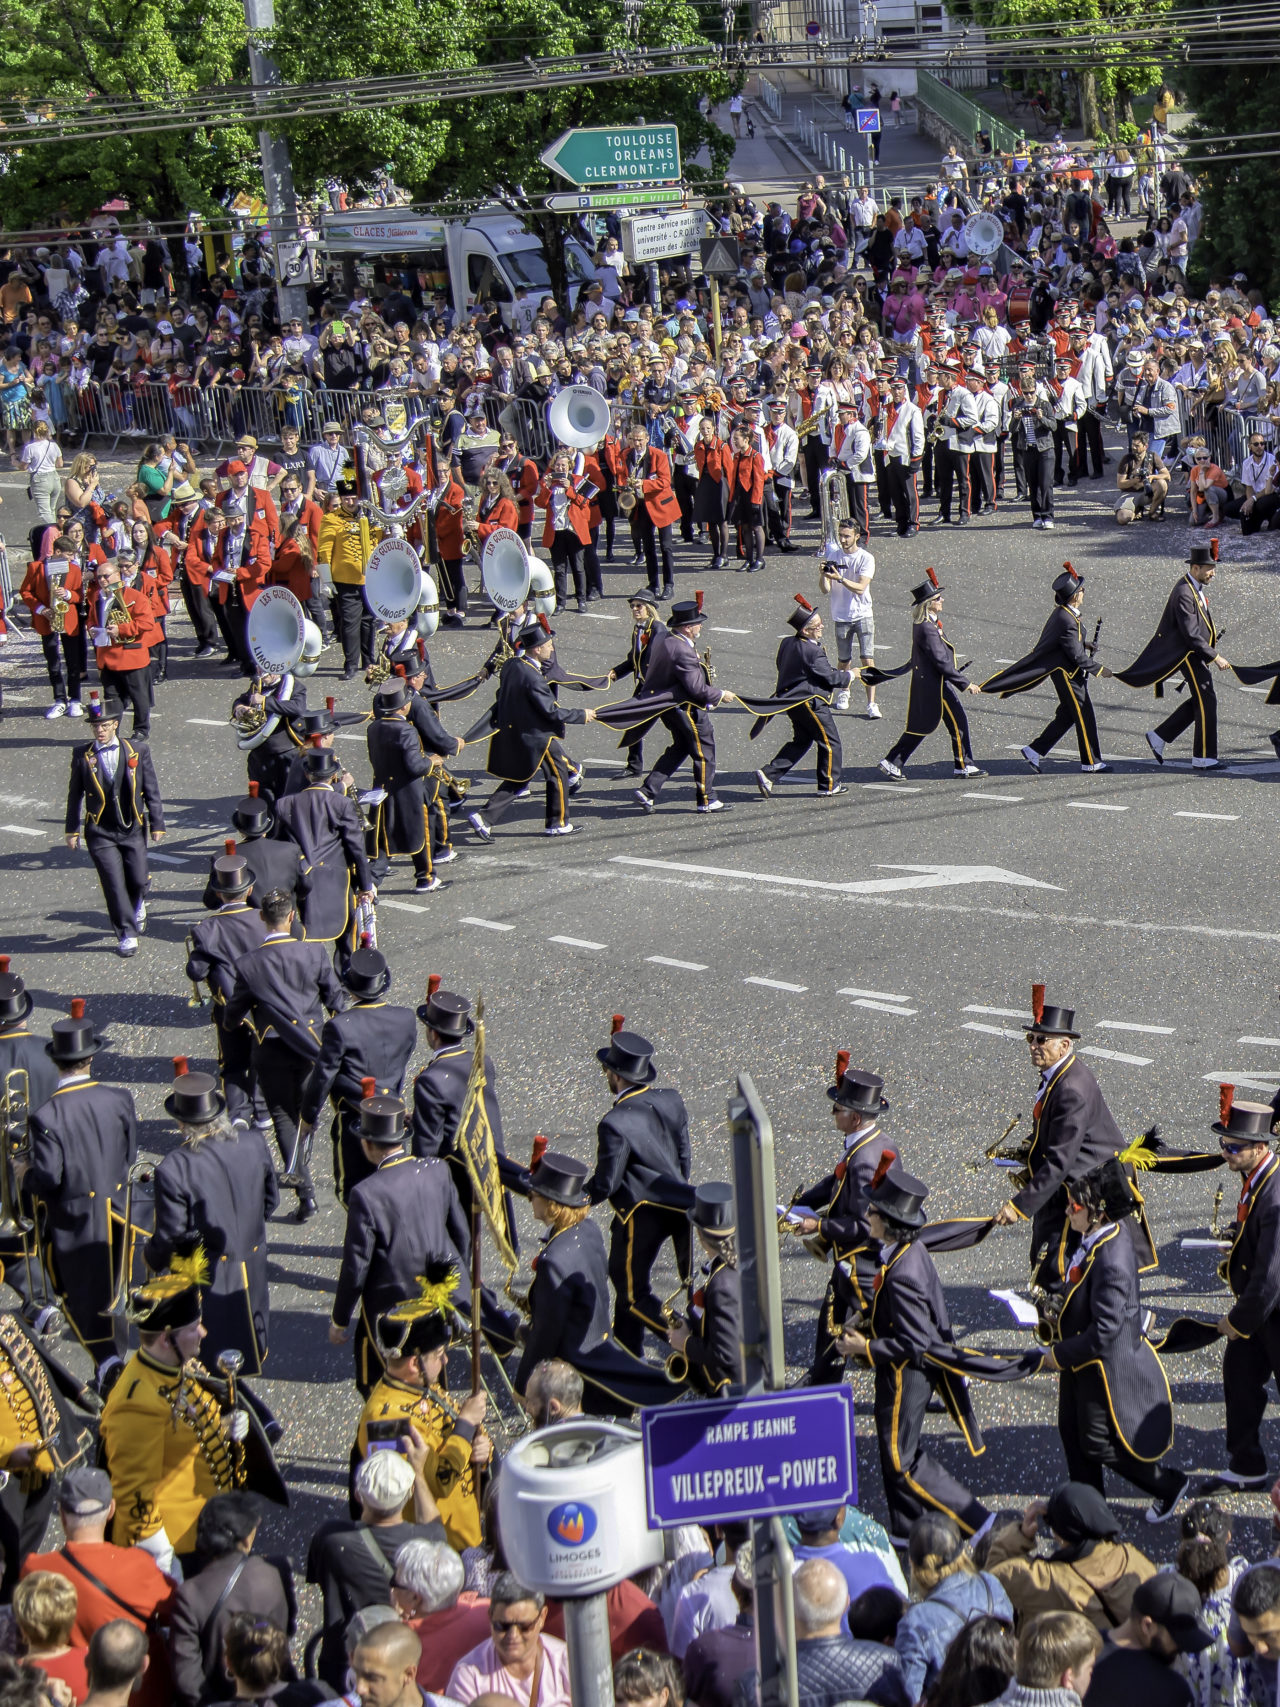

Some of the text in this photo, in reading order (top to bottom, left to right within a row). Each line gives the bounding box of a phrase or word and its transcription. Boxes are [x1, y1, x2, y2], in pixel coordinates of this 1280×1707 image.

[606, 133, 673, 147] TOULOUSE
[615, 148, 674, 161] ORLÉANS
[595, 194, 627, 206] HÔTEL
[632, 194, 643, 204] DE
[353, 226, 386, 237] GLACES
[636, 215, 704, 233] centre service national
[637, 232, 668, 245] université
[642, 246, 666, 255] campus
[667, 243, 678, 251] des
[680, 238, 701, 249] Jacobi
[289, 263, 301, 274] 30
[284, 460, 306, 470] LXRY
[486, 541, 496, 557] LES
[492, 530, 515, 544] GUEULES
[369, 554, 381, 571] LES
[378, 540, 404, 556] GUEULES
[259, 592, 272, 607] LES
[272, 589, 297, 609] GUEULES
[493, 591, 518, 609] LIMOGES
[377, 604, 407, 619] LIMOGES
[253, 646, 285, 673] LIMOGES
[706, 1415, 797, 1446] RAMPE JEANNE
[549, 1547, 602, 1563] LIMOGES
